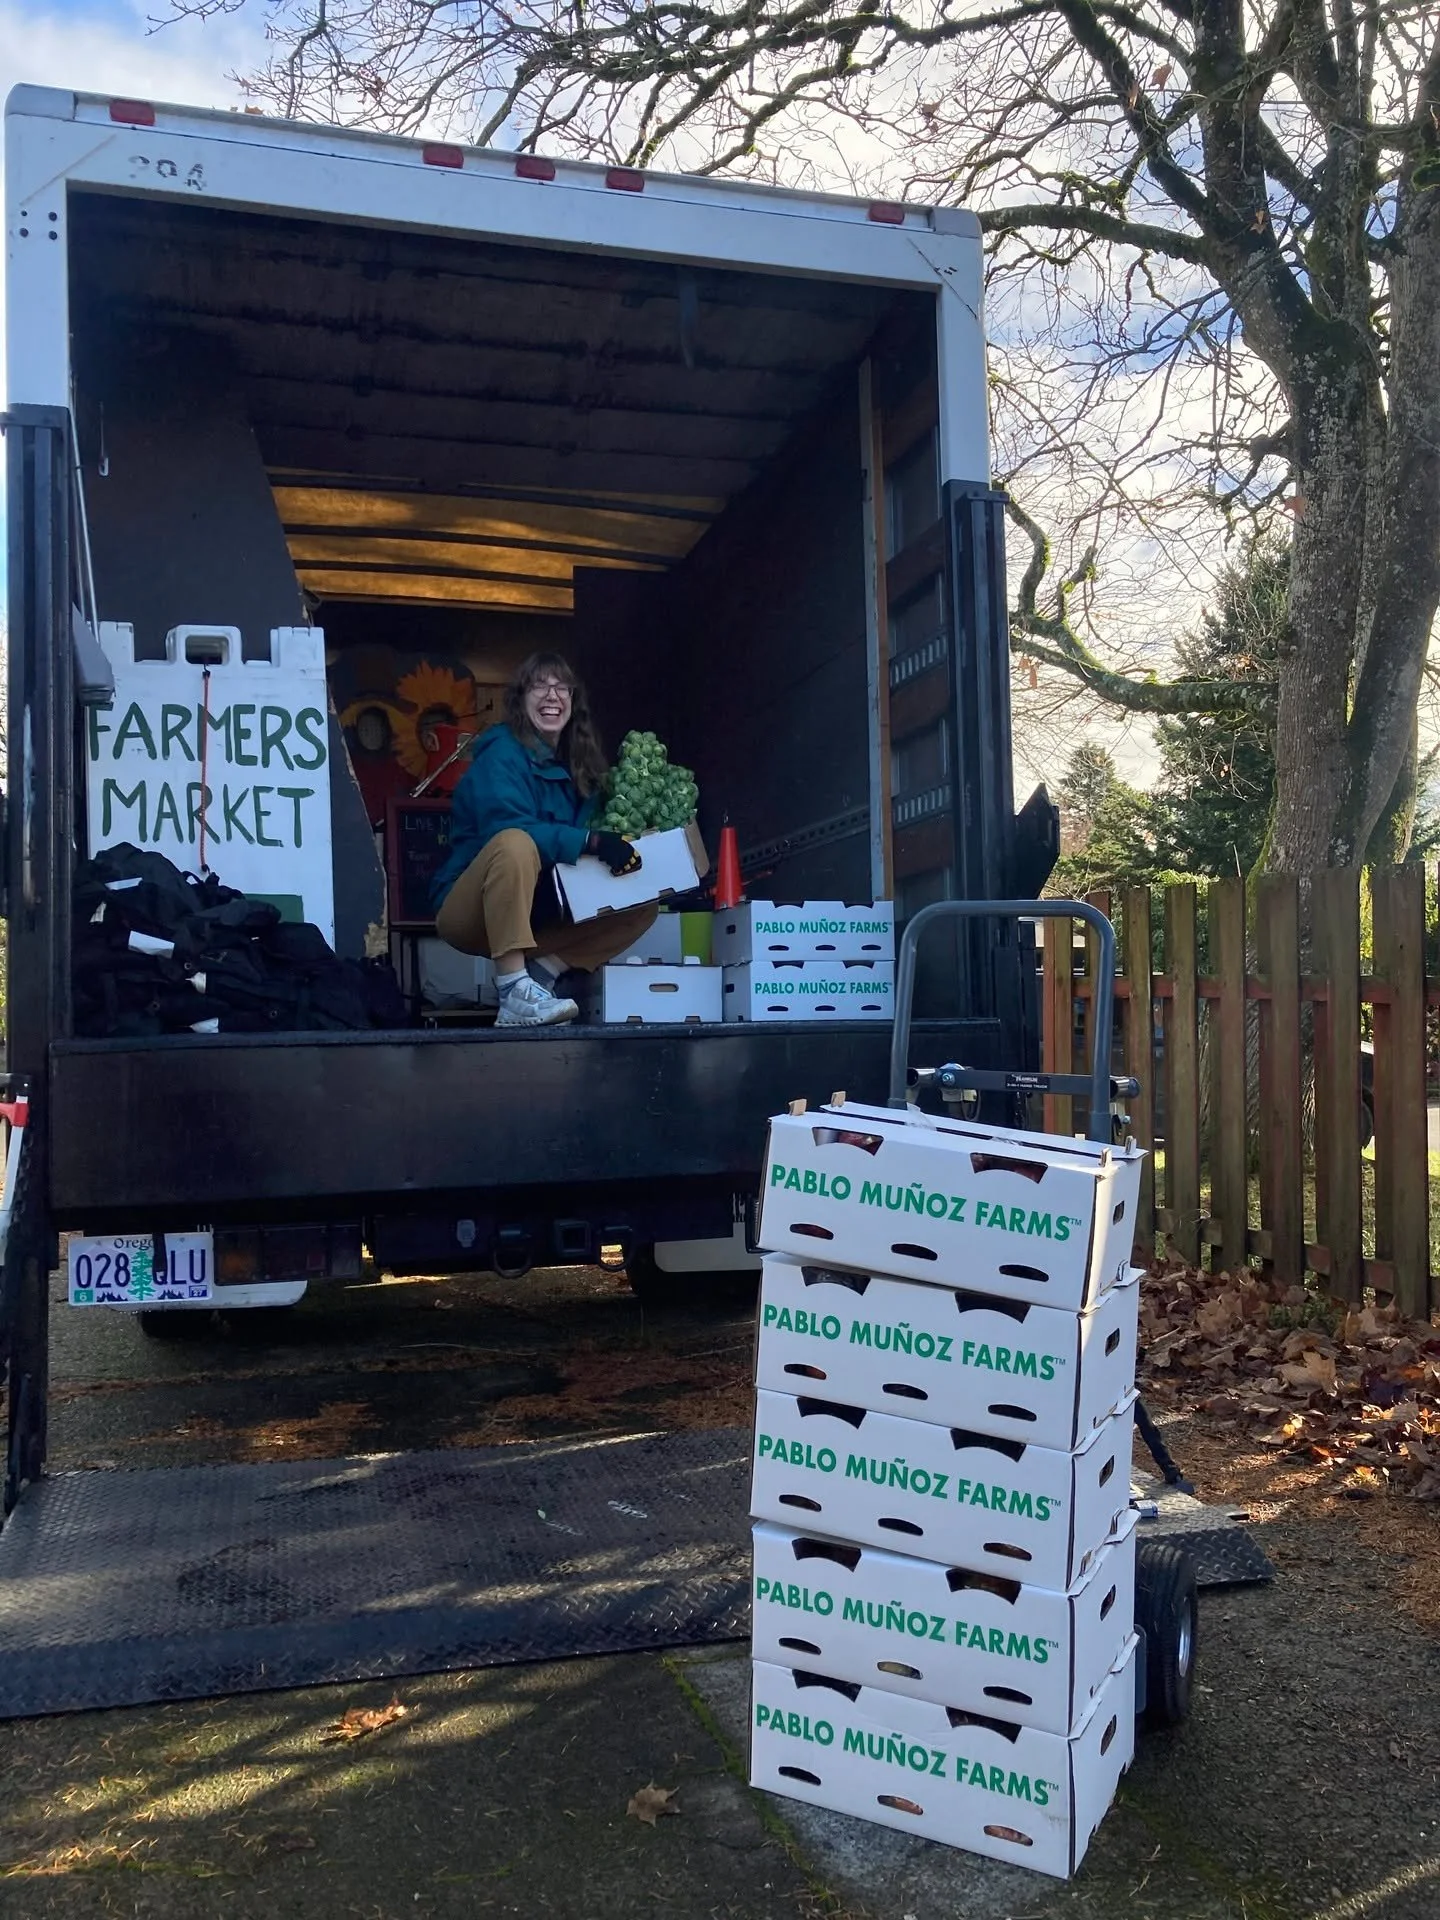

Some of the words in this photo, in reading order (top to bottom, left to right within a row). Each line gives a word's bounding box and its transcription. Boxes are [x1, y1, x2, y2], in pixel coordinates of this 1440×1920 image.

[87, 701, 327, 771] FARMERS
[102, 778, 315, 848] MARKET
[756, 921, 795, 934] PABLO
[799, 918, 846, 934] MUÑOZ
[755, 982, 795, 994] PABLO
[799, 979, 846, 994] MUÑOZ
[771, 1164, 851, 1201] PABLO
[859, 1182, 967, 1223] MUÑOZ
[75, 1252, 131, 1289] 028
[113, 1237, 154, 1251] Orego
[79, 1292, 87, 1301] 6
[764, 1304, 841, 1340] PABLO
[850, 1322, 953, 1362] MUÑOZ
[759, 1434, 837, 1473] PABLO
[845, 1456, 949, 1499] MUÑOZ
[756, 1577, 833, 1616] PABLO
[843, 1598, 946, 1642] MUÑOZ
[756, 1704, 834, 1746] PABLO
[843, 1728, 946, 1778] MUÑOZ
